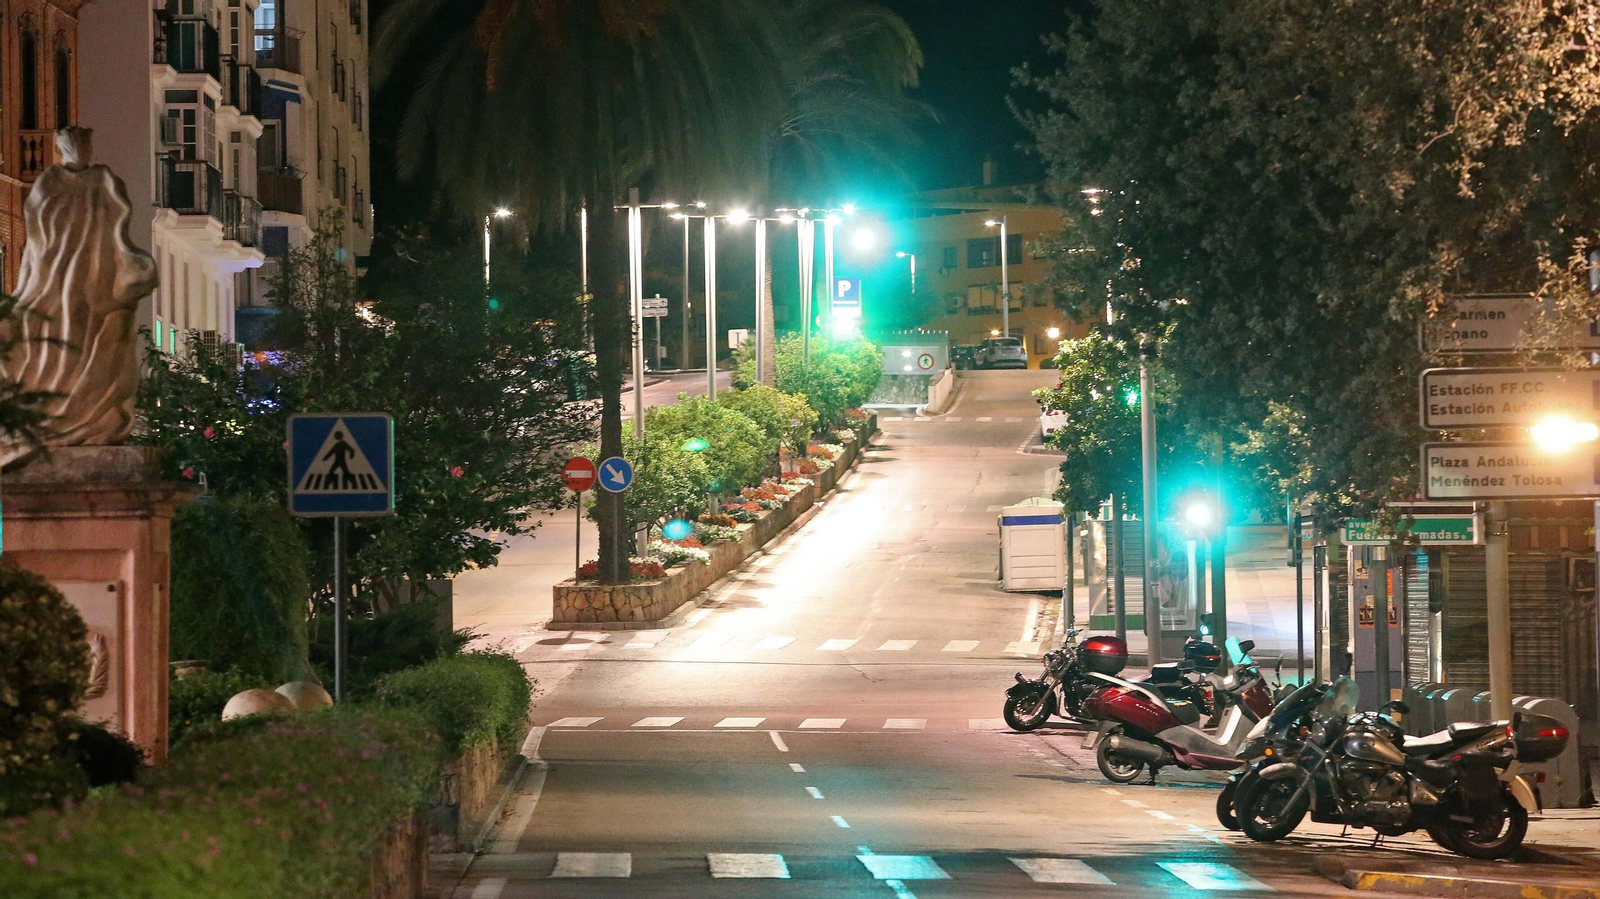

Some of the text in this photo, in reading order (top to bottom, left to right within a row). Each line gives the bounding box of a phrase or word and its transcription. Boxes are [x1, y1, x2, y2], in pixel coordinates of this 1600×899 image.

[838, 280, 851, 297] P
[1453, 308, 1506, 320] armen
[1429, 382, 1494, 397] Estación
[1430, 402, 1495, 416] Estación
[1430, 456, 1469, 468] Plaza
[1430, 474, 1562, 487] Menéndez Tolosa
[1405, 529, 1460, 540] madas
